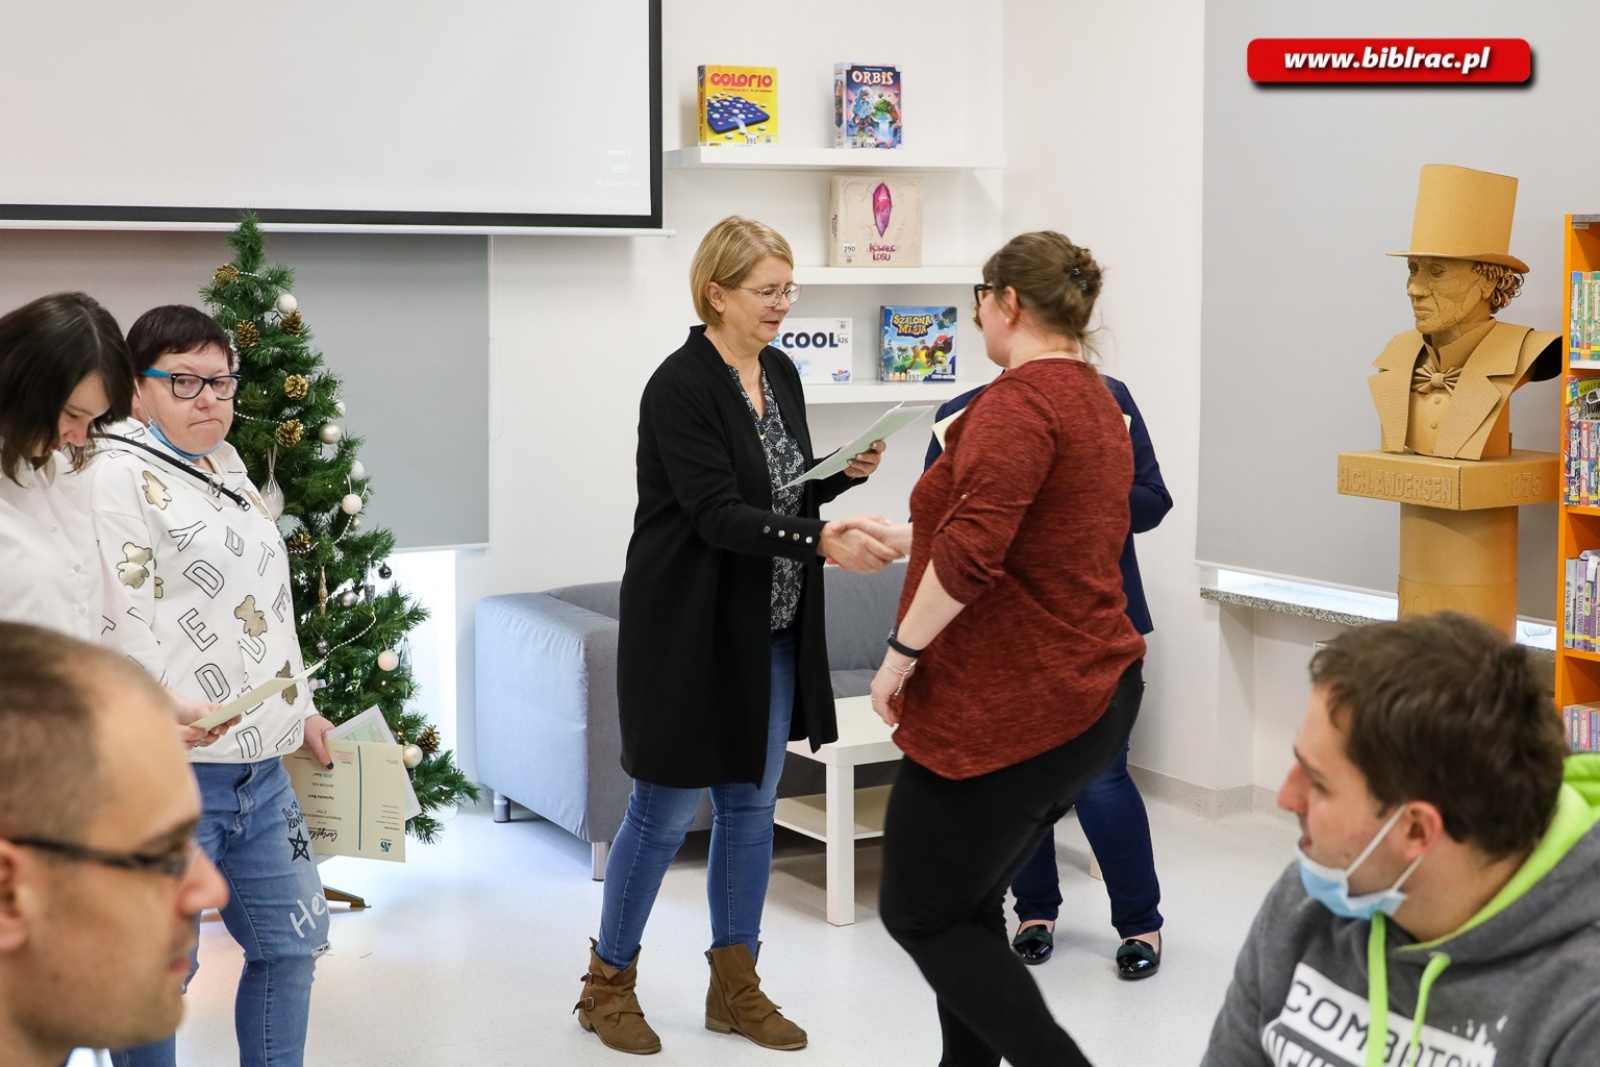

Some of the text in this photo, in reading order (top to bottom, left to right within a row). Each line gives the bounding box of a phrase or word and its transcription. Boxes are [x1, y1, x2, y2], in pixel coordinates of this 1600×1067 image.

[710, 73, 773, 88] COLORIO
[852, 70, 894, 86] ORBIS
[843, 245, 856, 253] 290
[872, 253, 892, 261] LOSU
[893, 314, 932, 326] SZALONA
[898, 324, 927, 335] MISJA
